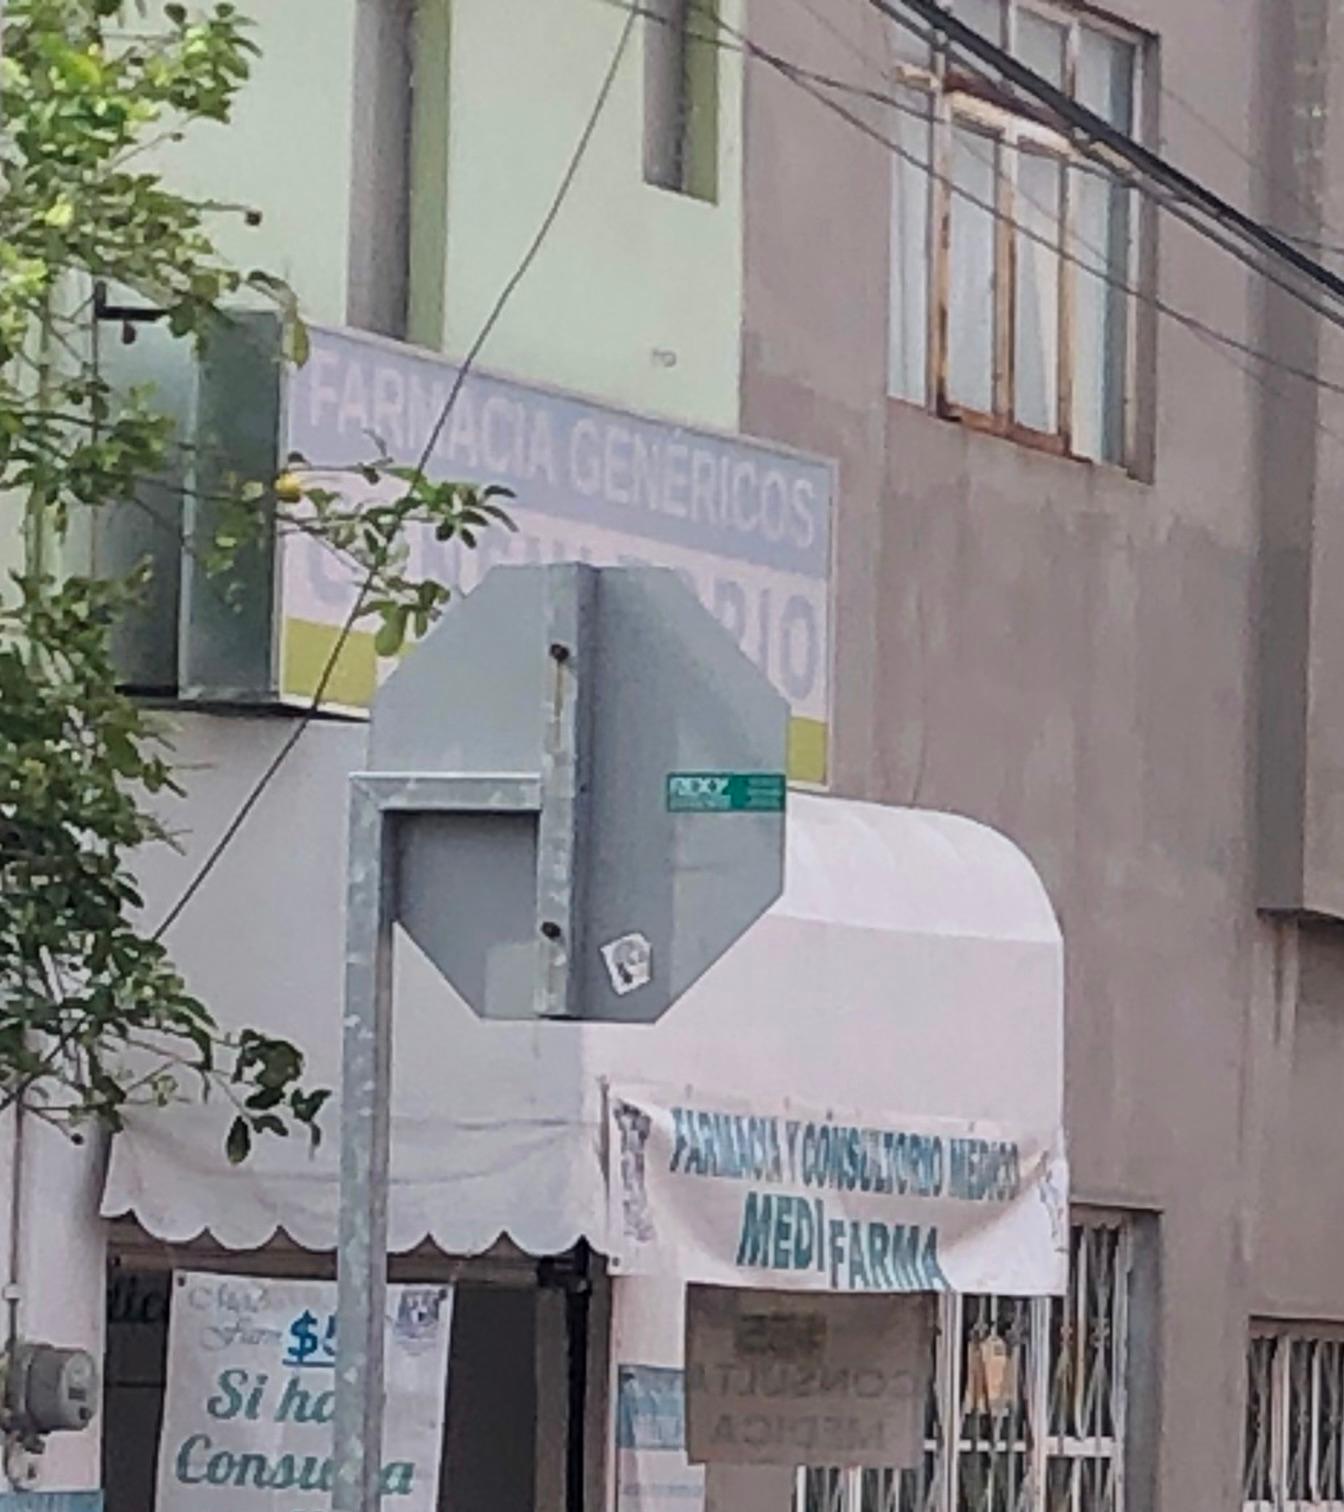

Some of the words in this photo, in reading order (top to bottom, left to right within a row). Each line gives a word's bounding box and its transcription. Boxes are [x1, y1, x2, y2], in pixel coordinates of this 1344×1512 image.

[309, 347, 556, 484] FARMACIA
[569, 418, 818, 549] GENÉRICOS
[207, 1368, 268, 1421] Si
